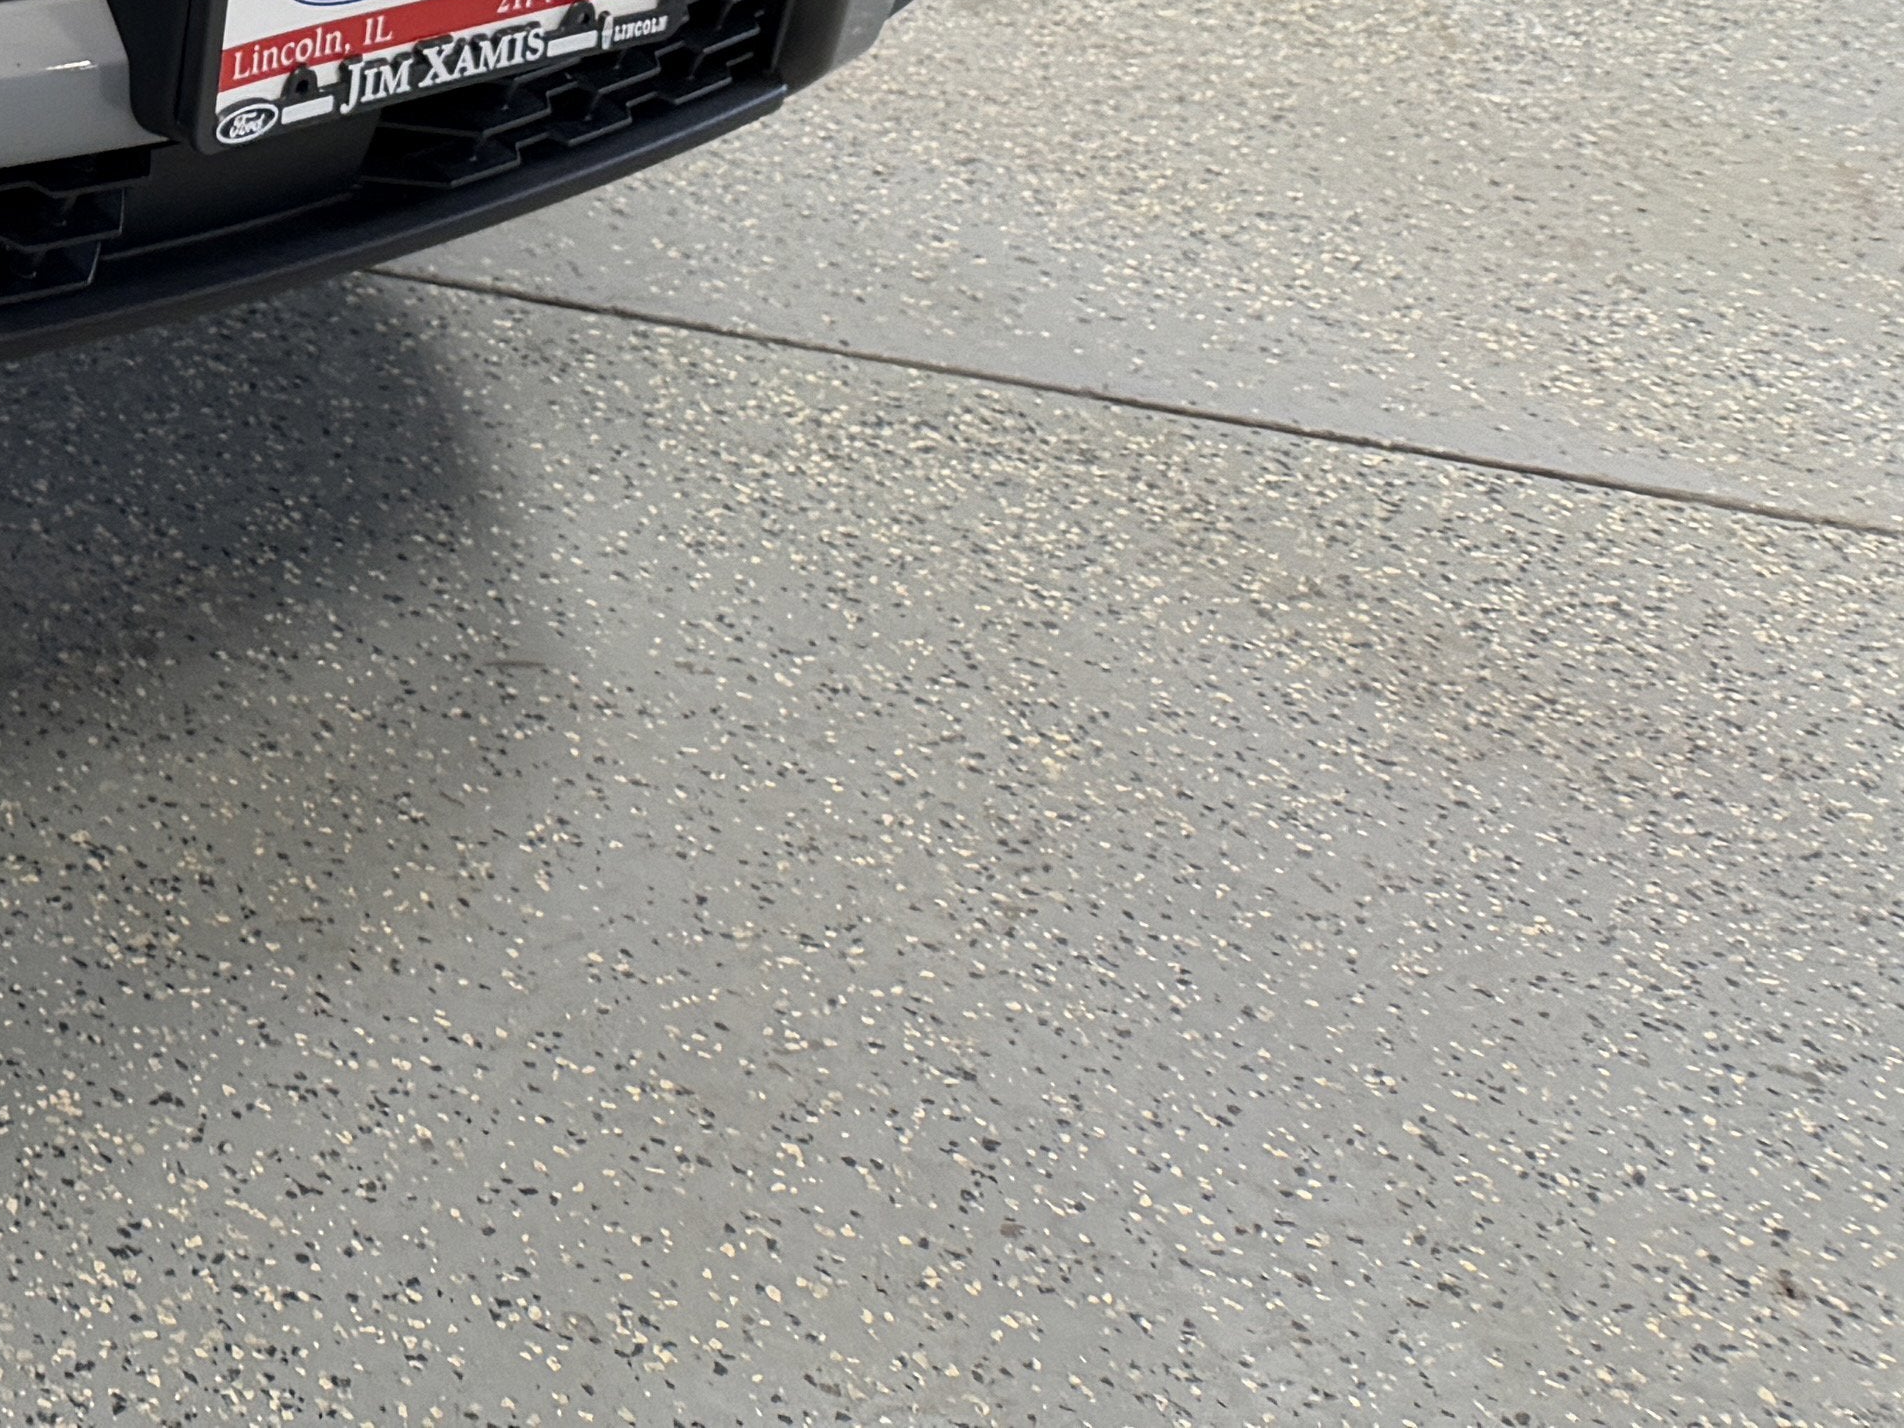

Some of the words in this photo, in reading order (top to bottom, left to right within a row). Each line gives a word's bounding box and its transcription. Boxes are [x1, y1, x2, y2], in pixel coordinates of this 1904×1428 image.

[233, 28, 352, 80] Lincoln,
[363, 17, 392, 46] IL
[613, 15, 668, 42] LINCOLN
[340, 60, 412, 113] JIM
[419, 27, 546, 87] XAMIS
[227, 110, 265, 137] Ford
